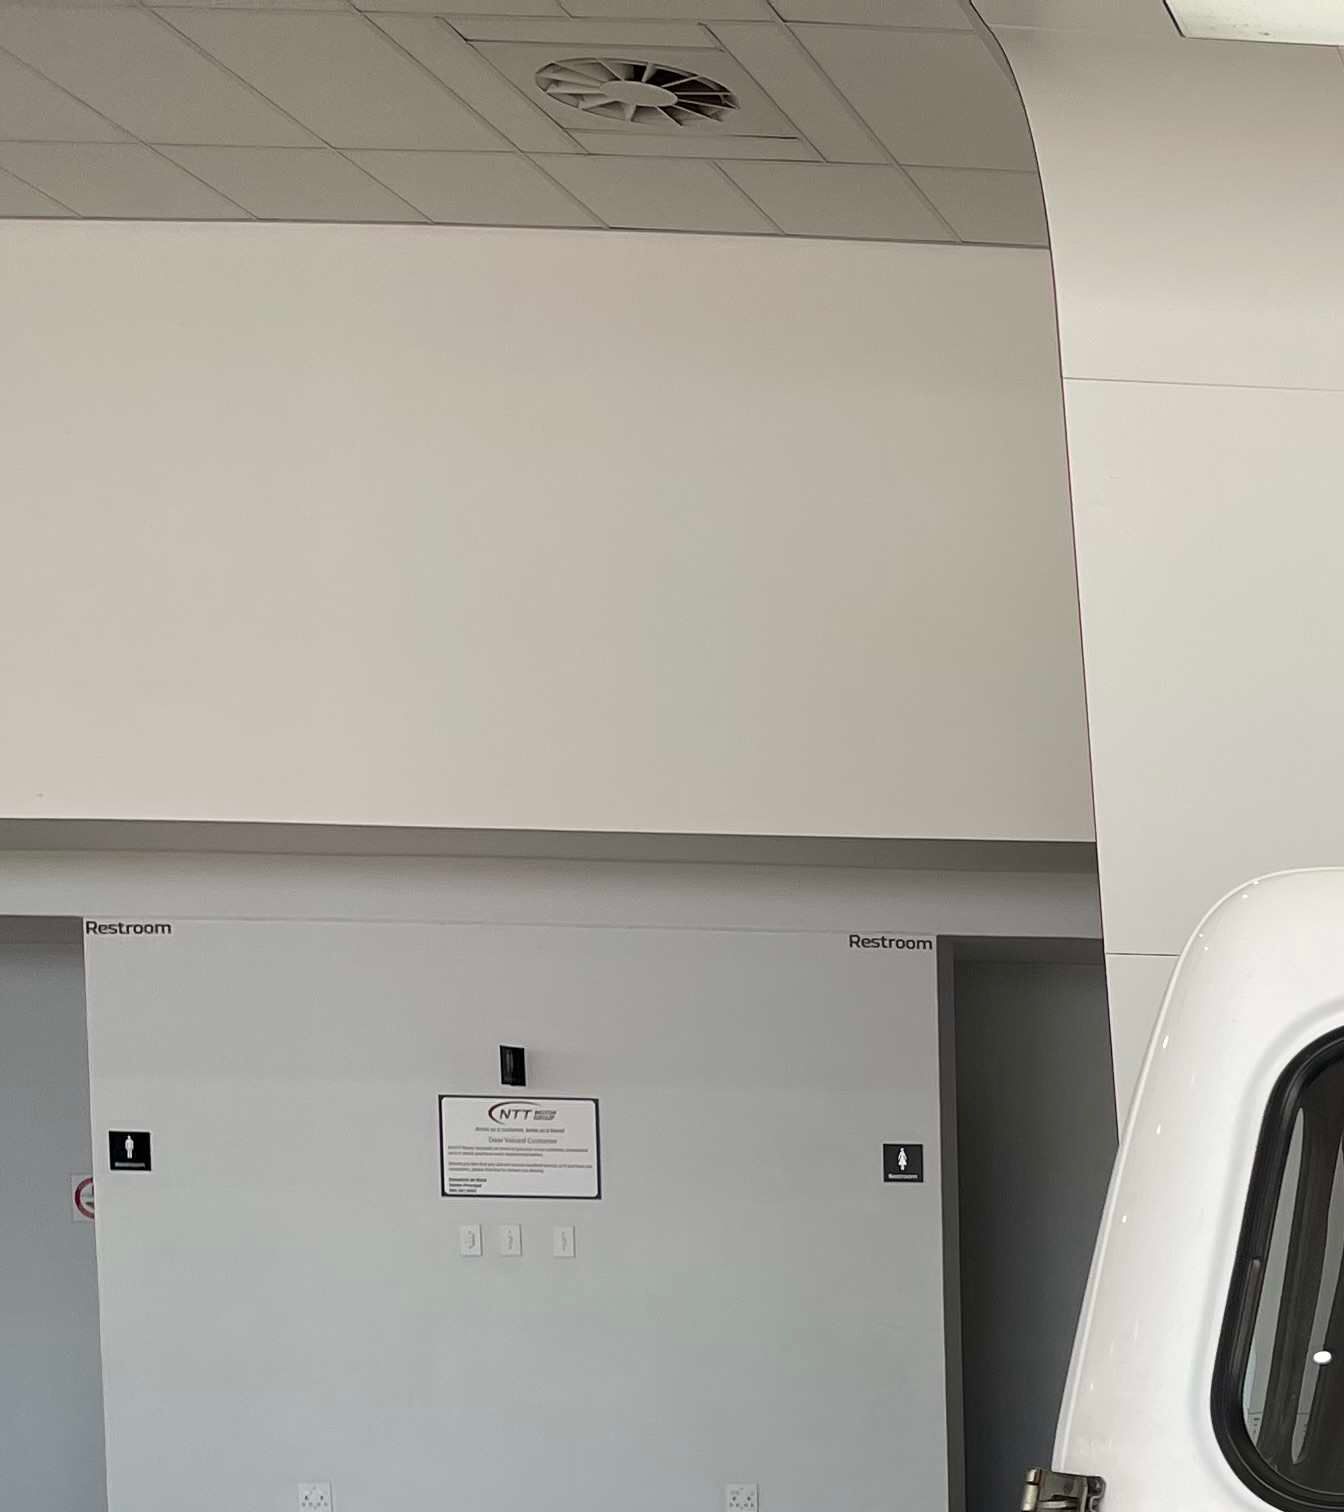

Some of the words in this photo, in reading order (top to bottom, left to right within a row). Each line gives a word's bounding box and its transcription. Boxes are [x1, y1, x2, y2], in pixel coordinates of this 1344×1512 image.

[85, 920, 172, 935] Restroom
[849, 934, 933, 950] Restroom
[500, 1109, 533, 1121] NTT
